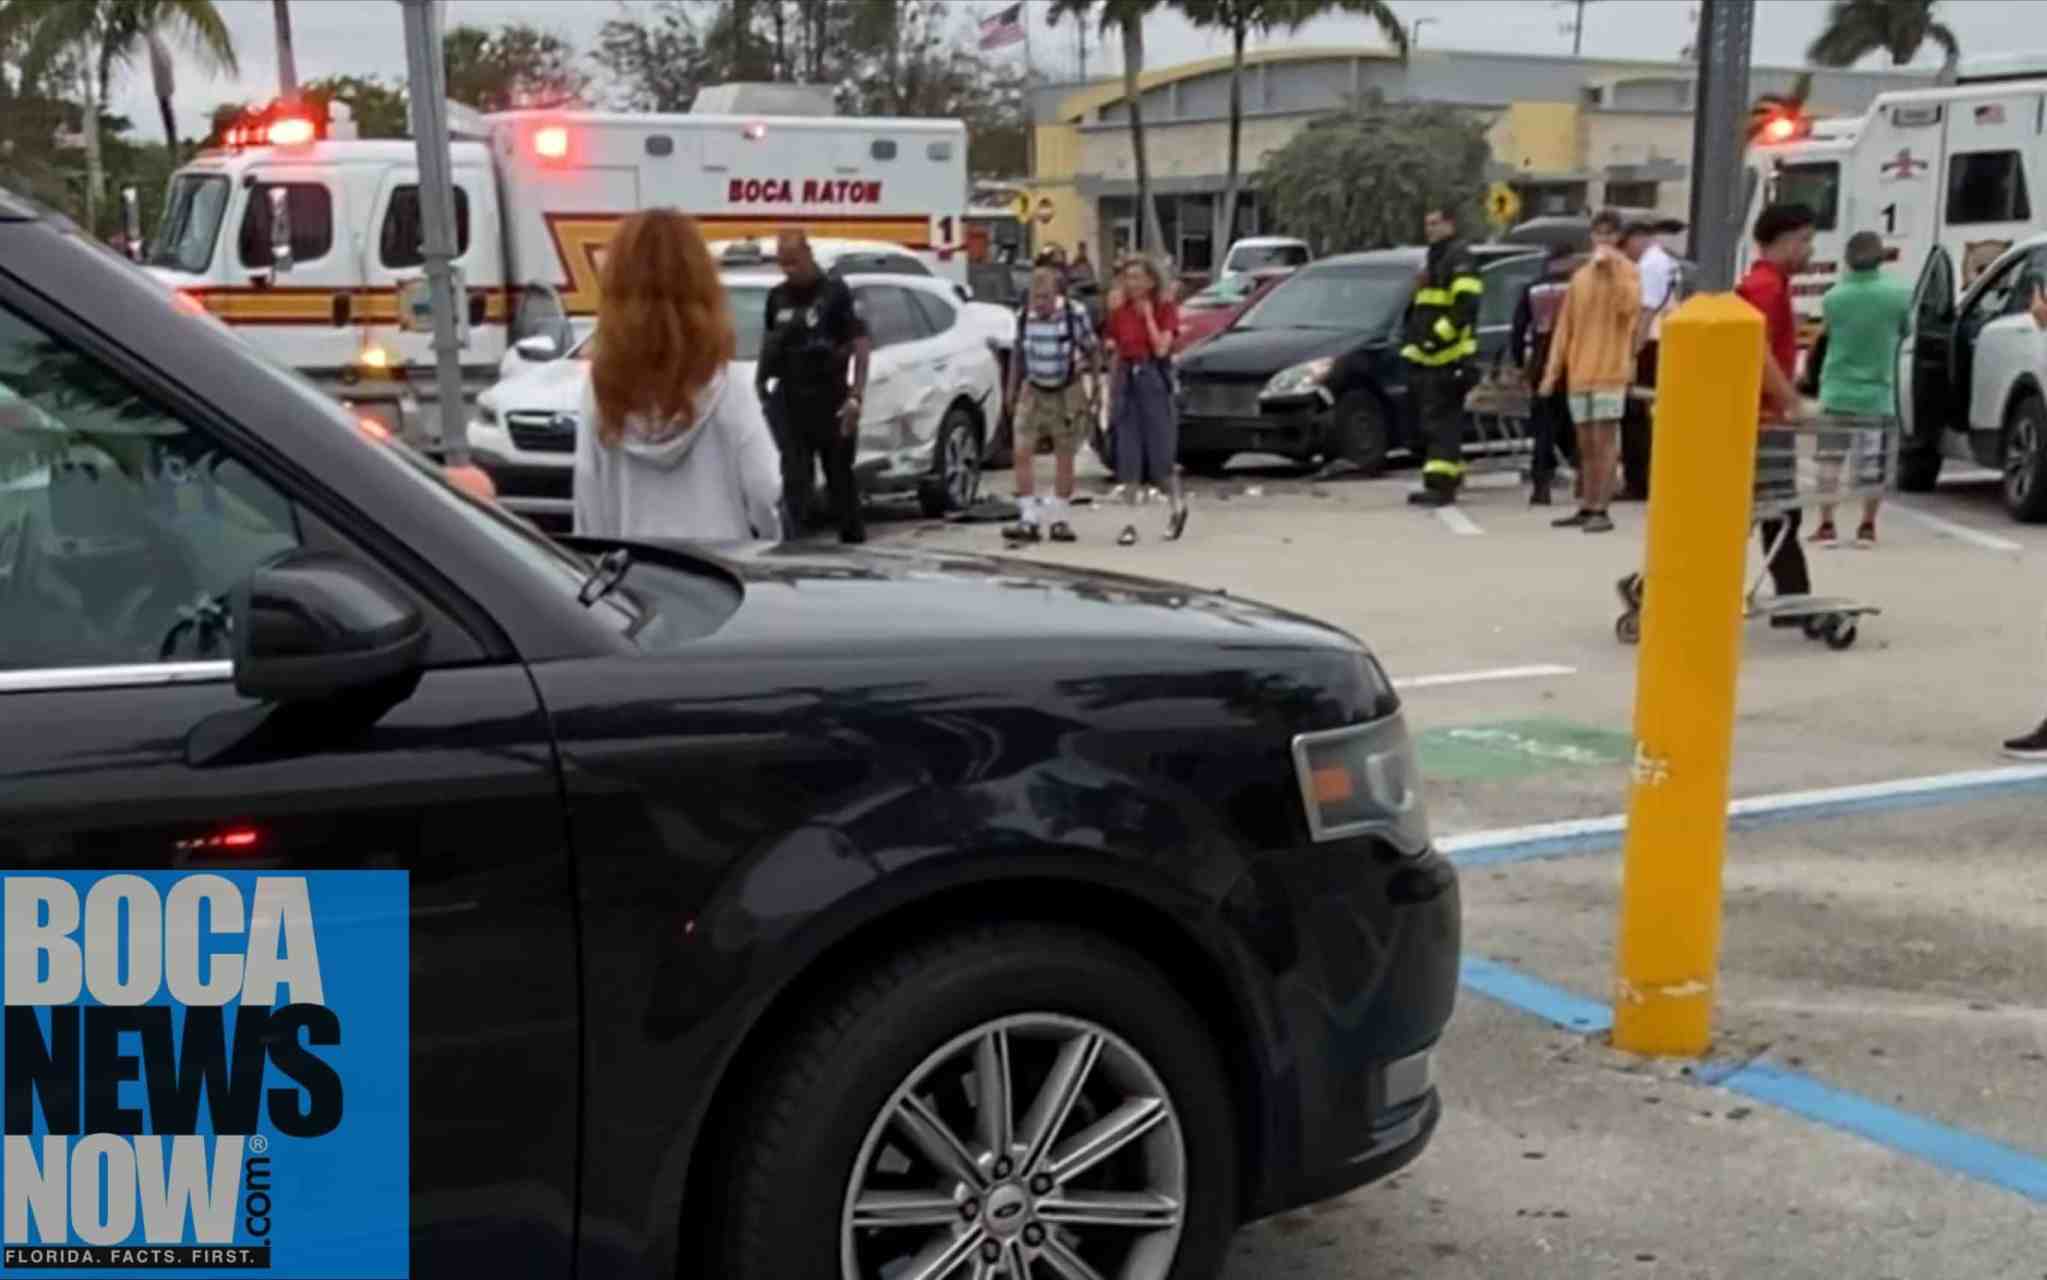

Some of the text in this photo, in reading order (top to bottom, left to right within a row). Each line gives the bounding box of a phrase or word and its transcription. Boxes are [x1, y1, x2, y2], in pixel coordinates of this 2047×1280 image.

[728, 178, 882, 204] BOCA RATON
[938, 215, 953, 244] 1
[1881, 203, 1896, 233] 1
